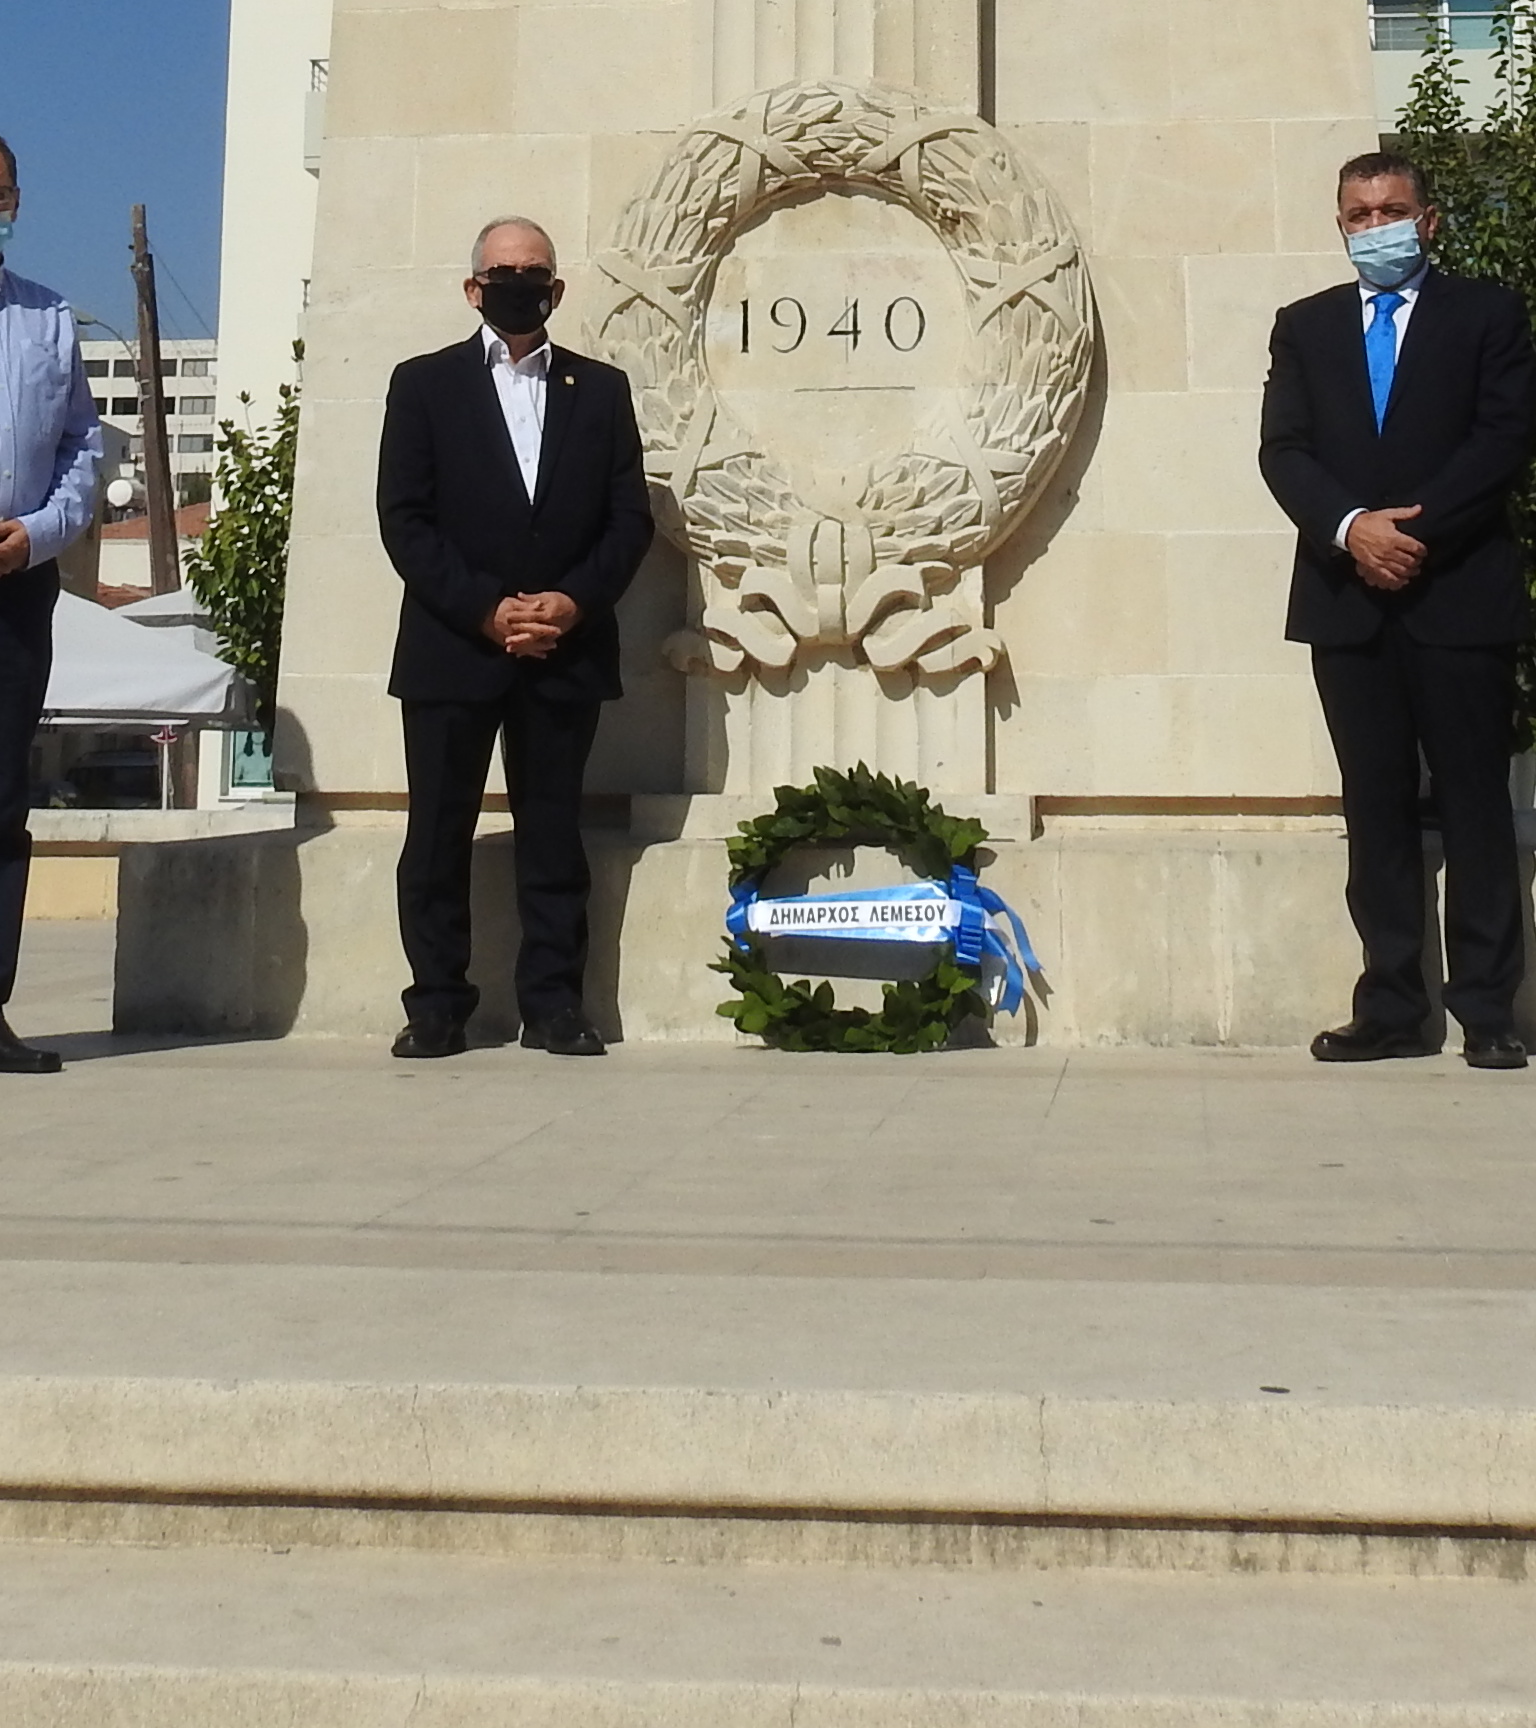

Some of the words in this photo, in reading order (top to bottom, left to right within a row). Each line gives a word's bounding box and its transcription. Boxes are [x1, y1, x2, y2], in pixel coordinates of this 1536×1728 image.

[740, 296, 926, 353] 1940
[769, 905, 861, 926] ΔΗΜΑΡΧΟΣ
[869, 903, 948, 923] ΛΕΜΕΣΟΥ
